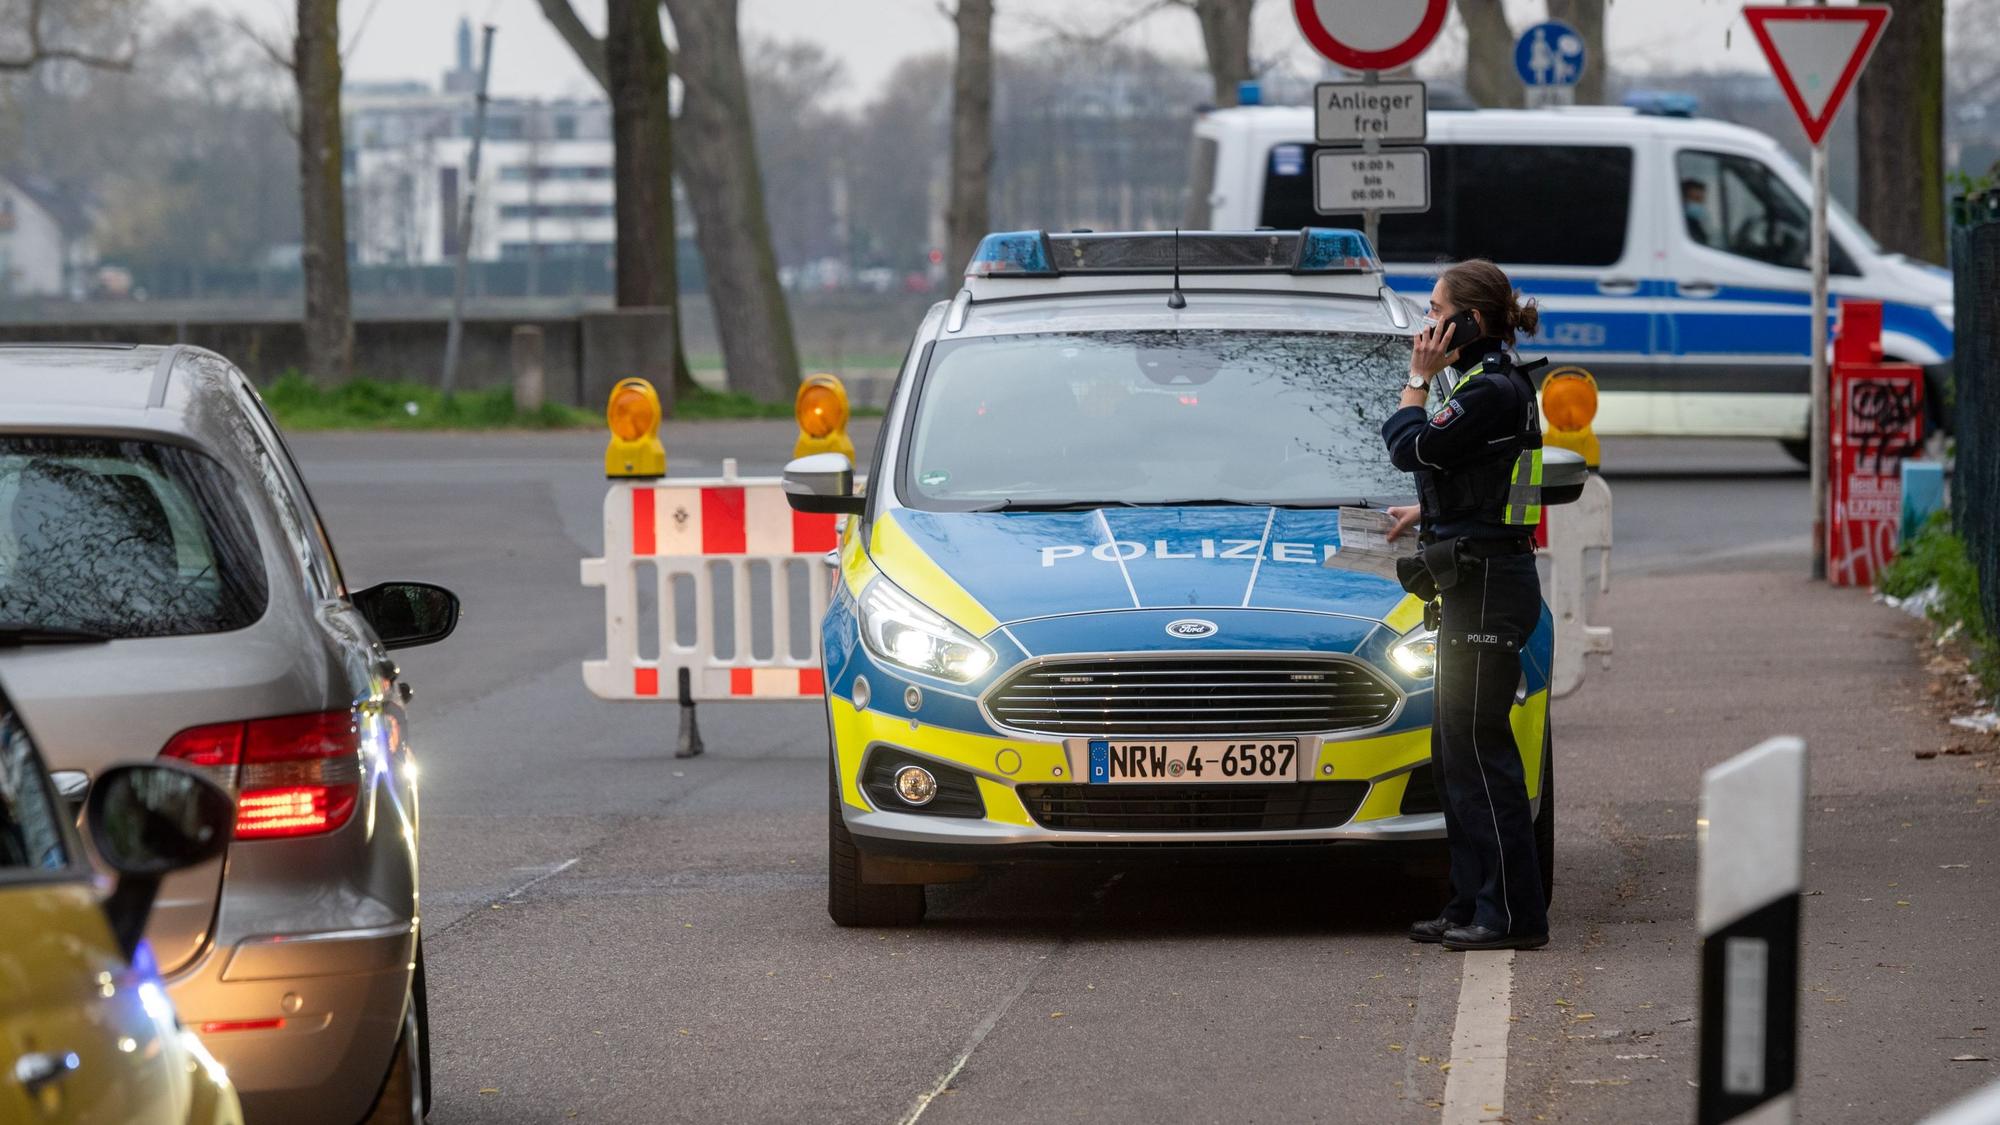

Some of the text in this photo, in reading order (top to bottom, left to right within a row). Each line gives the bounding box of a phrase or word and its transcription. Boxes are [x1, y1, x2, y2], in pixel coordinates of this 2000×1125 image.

[1328, 91, 1412, 114] Anlieger
[1355, 115, 1388, 132] frei
[1386, 160, 1394, 171] h
[1363, 174, 1382, 186] bis
[1387, 189, 1395, 200] h
[1178, 624, 1205, 633] Ford
[1467, 634, 1498, 643] POLIZEI
[1109, 744, 1296, 778] NRW 4-6587
[1095, 766, 1104, 777] D
